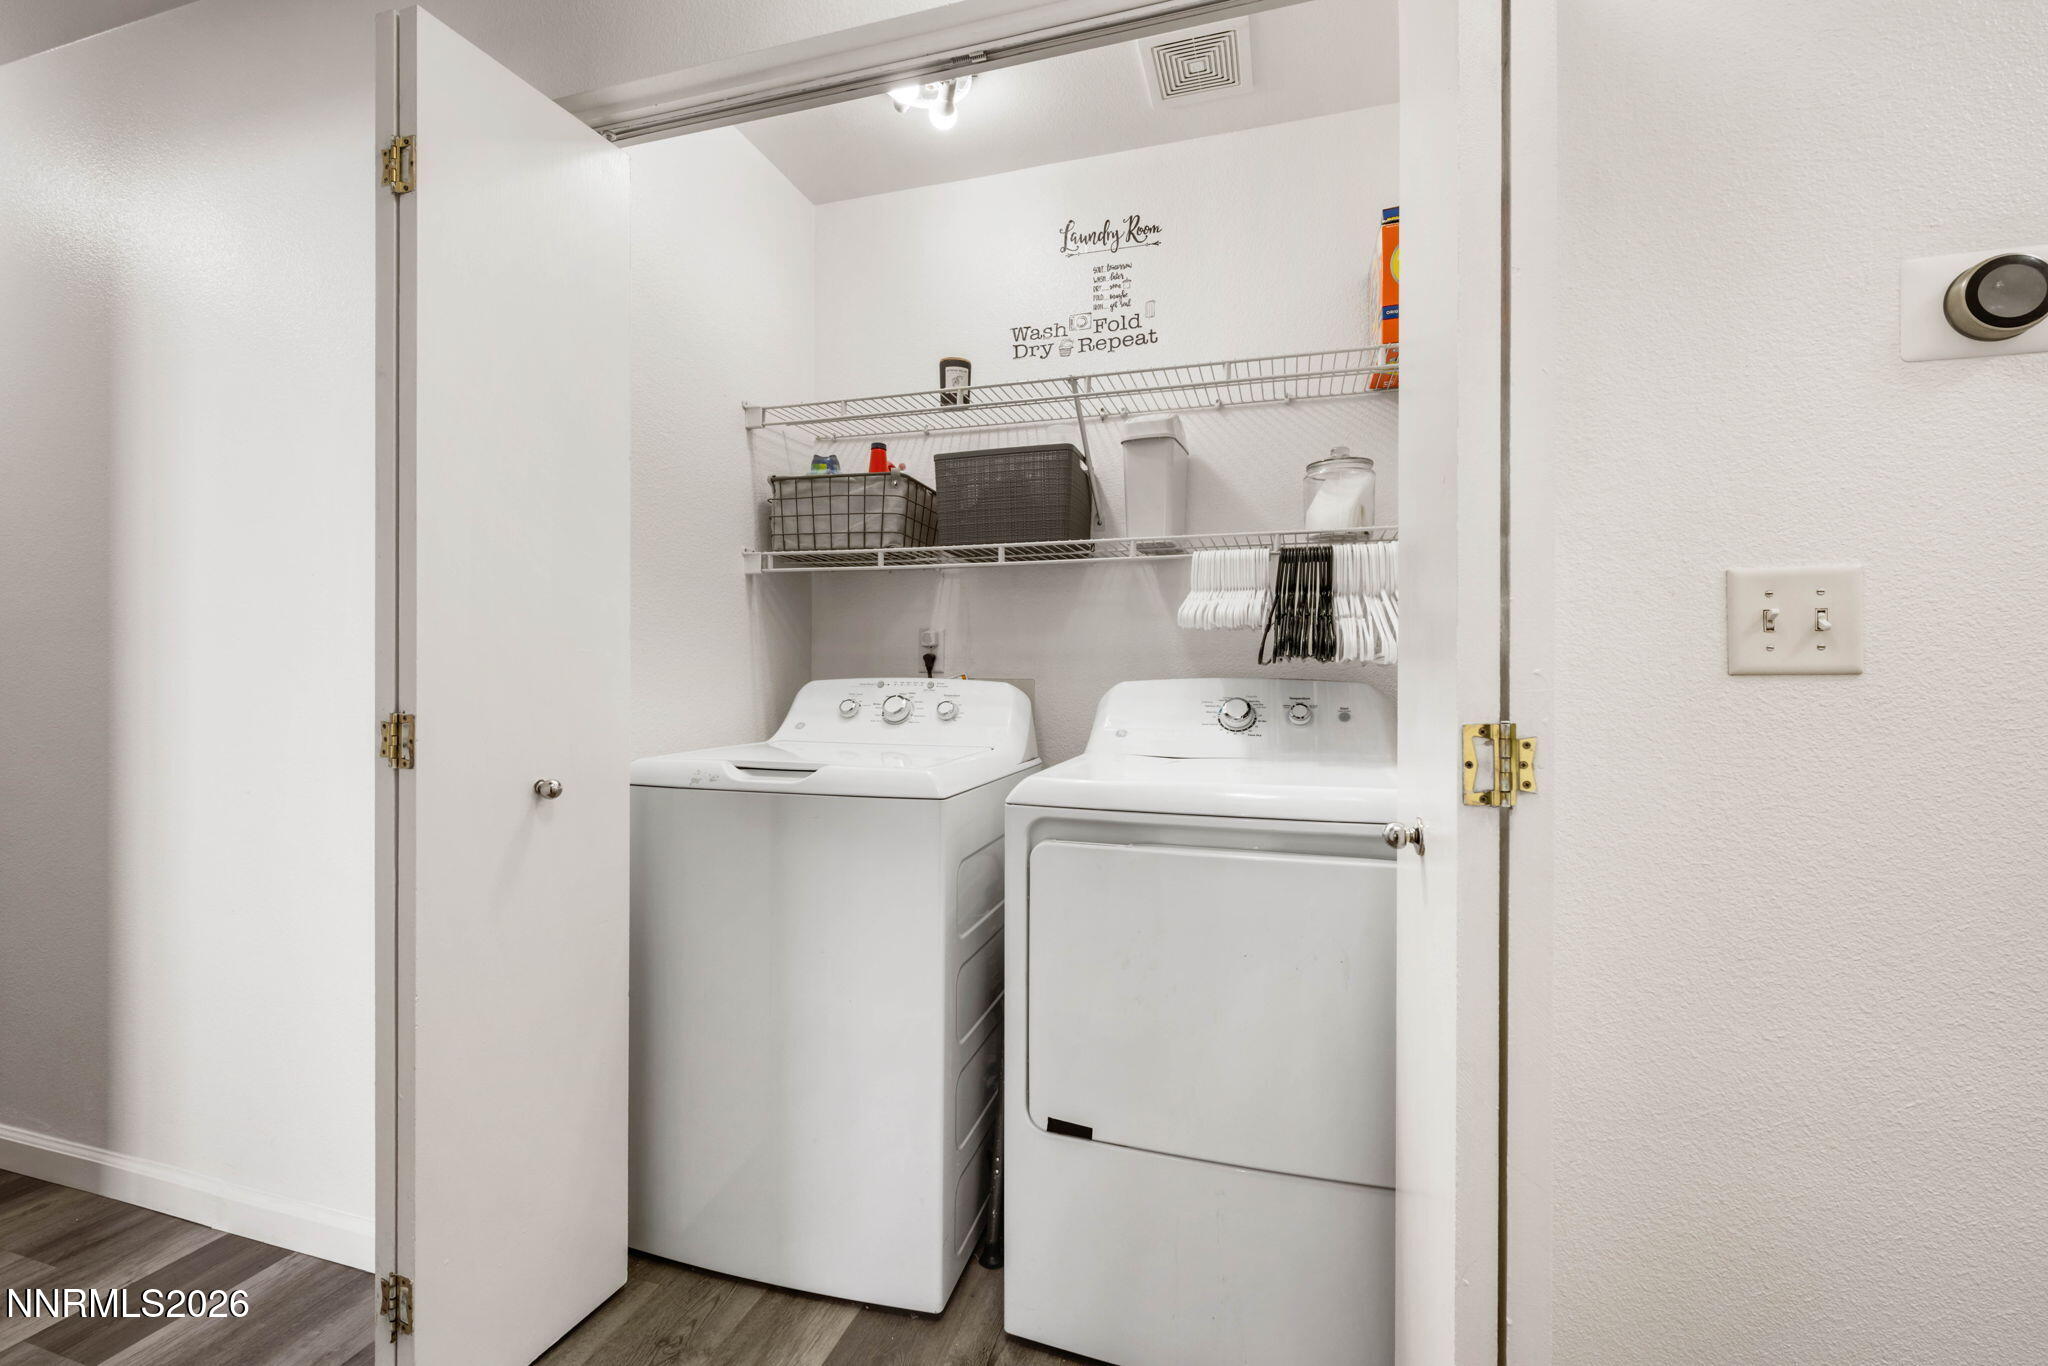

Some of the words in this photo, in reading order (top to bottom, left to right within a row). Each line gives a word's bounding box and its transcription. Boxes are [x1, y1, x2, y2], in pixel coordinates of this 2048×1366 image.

[1059, 219, 1124, 253] Laundry
[1123, 214, 1163, 244] Room
[1110, 272, 1124, 281] later
[1109, 290, 1129, 300] maybe
[1011, 322, 1068, 342] Wash
[1093, 313, 1143, 334] Fold
[1012, 342, 1055, 360] Dry
[1077, 329, 1158, 353] Repeat
